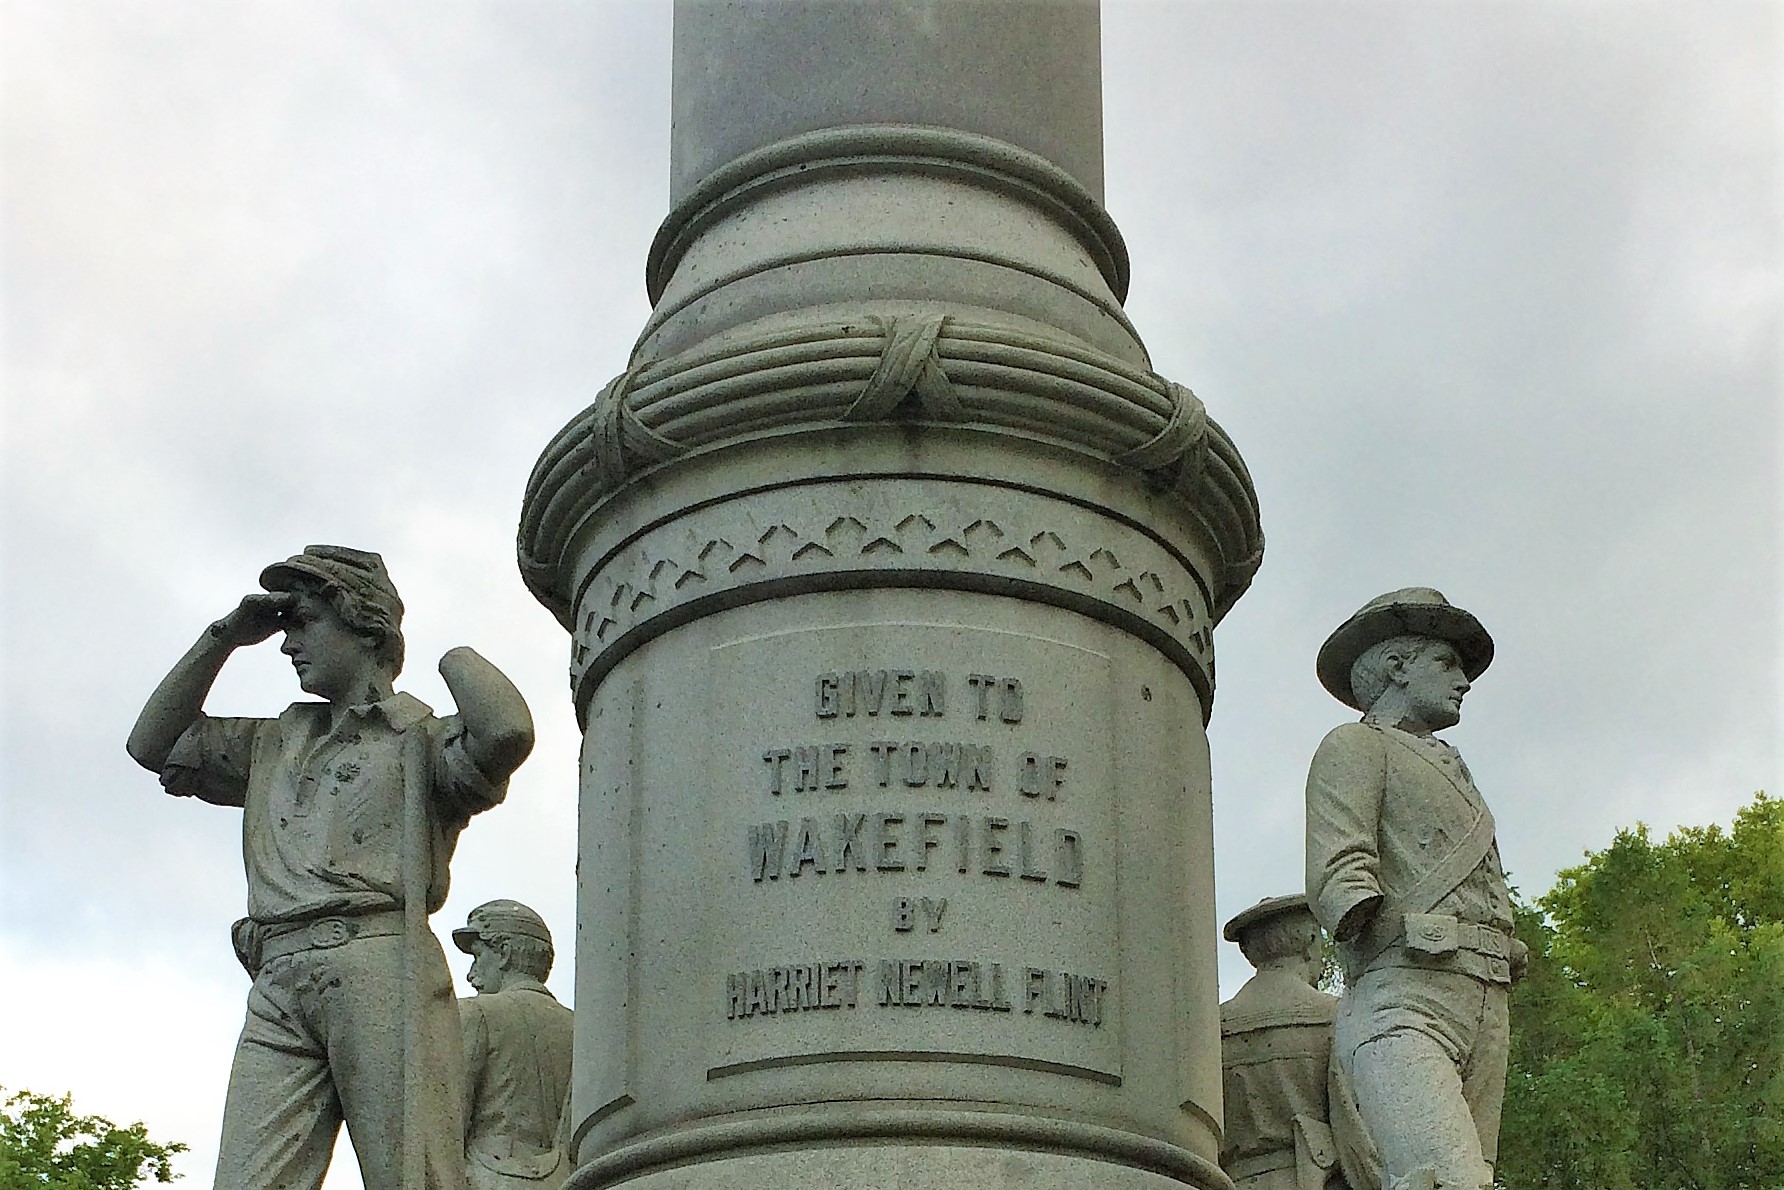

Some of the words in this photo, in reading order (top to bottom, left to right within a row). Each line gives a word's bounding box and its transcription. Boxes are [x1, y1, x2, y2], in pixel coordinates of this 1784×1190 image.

[815, 669, 946, 719] GIVEN
[968, 672, 1024, 724] TO
[762, 743, 852, 795] THE
[870, 741, 992, 793] TOWN
[1019, 751, 1069, 801] OF
[748, 812, 1082, 889] WAKEFIELD
[895, 897, 948, 932] BY
[726, 960, 863, 1020] HARRIET
[878, 959, 1011, 1013] NEWELL
[1023, 966, 1108, 1027] FLINT
